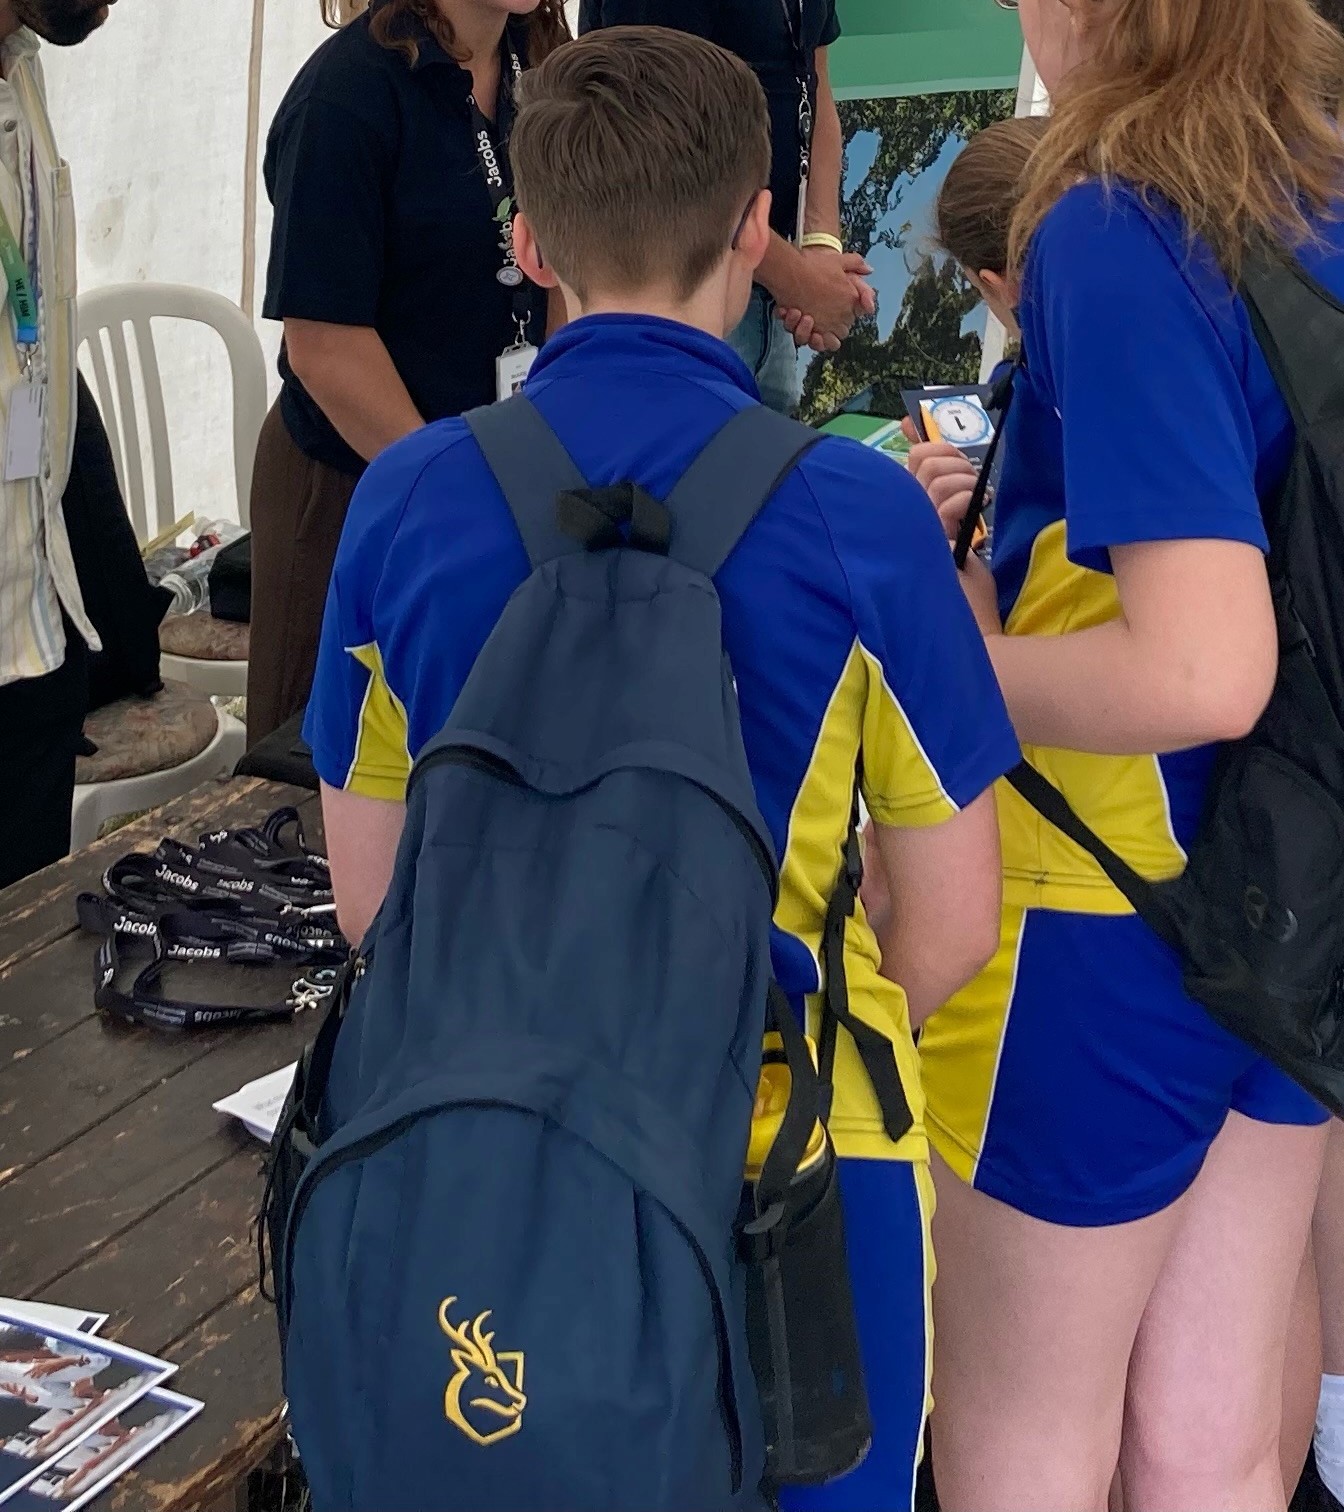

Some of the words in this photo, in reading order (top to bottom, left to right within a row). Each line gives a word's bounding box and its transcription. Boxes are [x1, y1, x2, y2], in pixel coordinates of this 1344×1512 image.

[477, 129, 502, 188] Jacobs
[155, 864, 199, 892] Jacobs
[113, 916, 157, 935] Jacob
[167, 944, 221, 958] Jacobs
